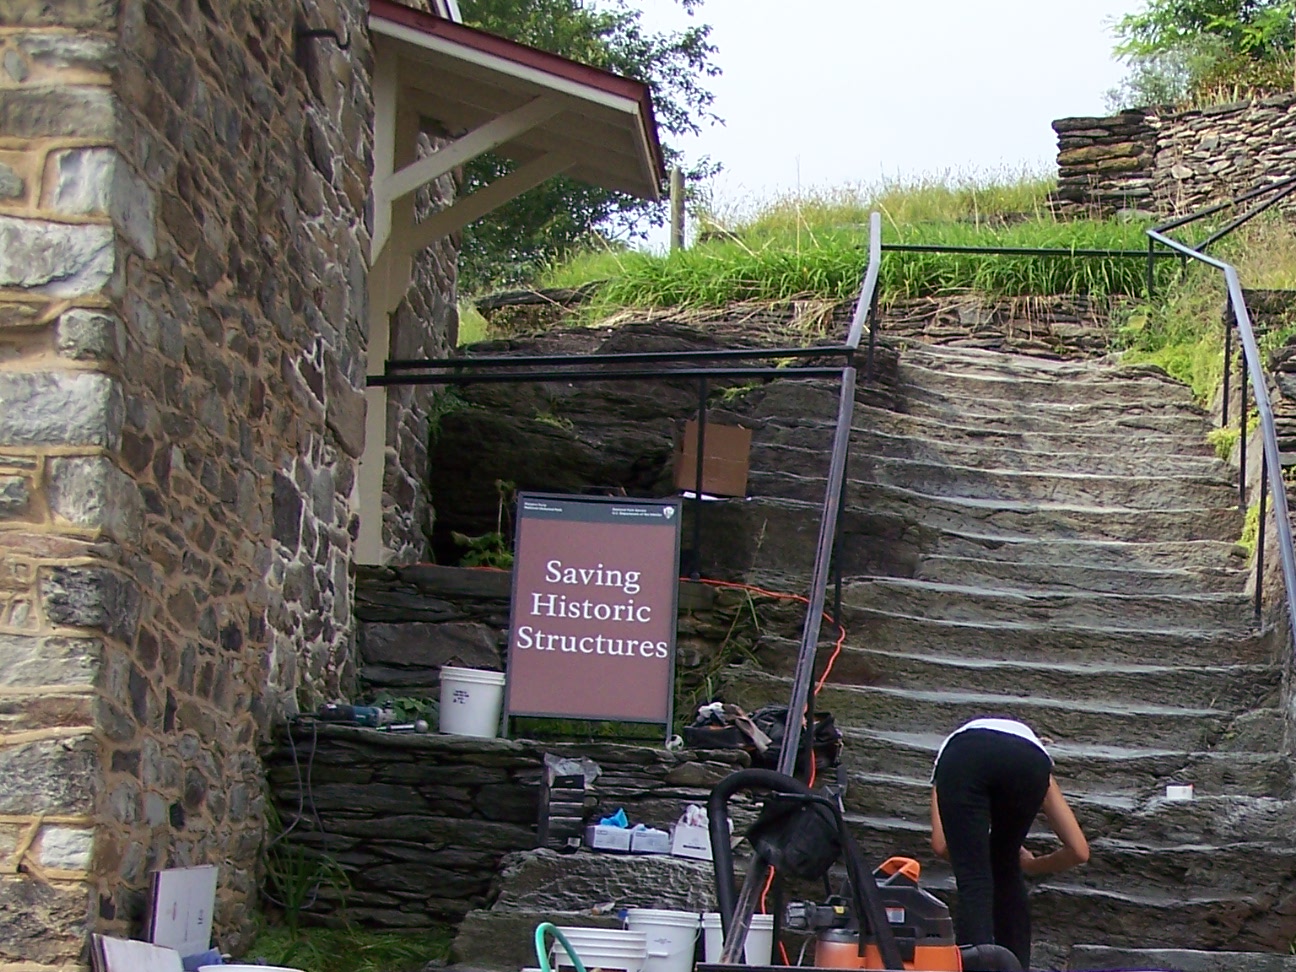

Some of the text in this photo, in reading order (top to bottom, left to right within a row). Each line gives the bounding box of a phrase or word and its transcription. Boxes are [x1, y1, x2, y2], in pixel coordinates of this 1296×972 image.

[546, 560, 641, 594] Saving
[530, 592, 651, 623] Historic
[516, 626, 668, 658] Structures
